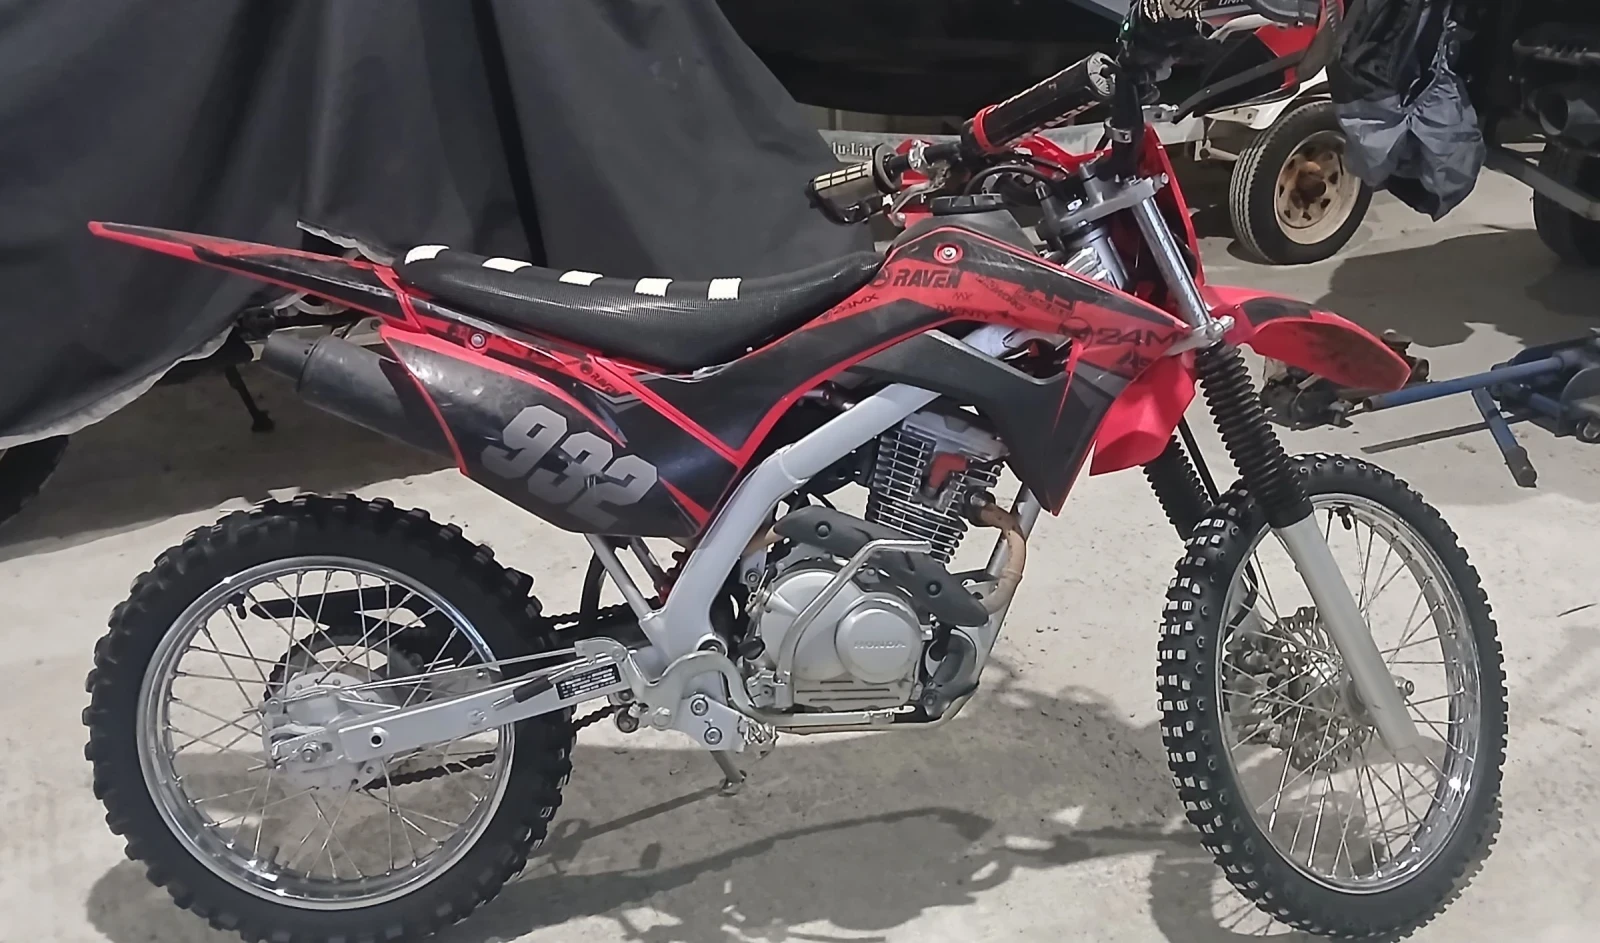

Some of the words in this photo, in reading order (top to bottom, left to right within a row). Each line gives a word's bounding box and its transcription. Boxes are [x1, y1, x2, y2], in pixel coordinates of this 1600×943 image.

[893, 269, 963, 288] RAVEN
[1096, 328, 1187, 346] 24M
[481, 404, 658, 530] 932
[852, 639, 907, 650] HONDA
